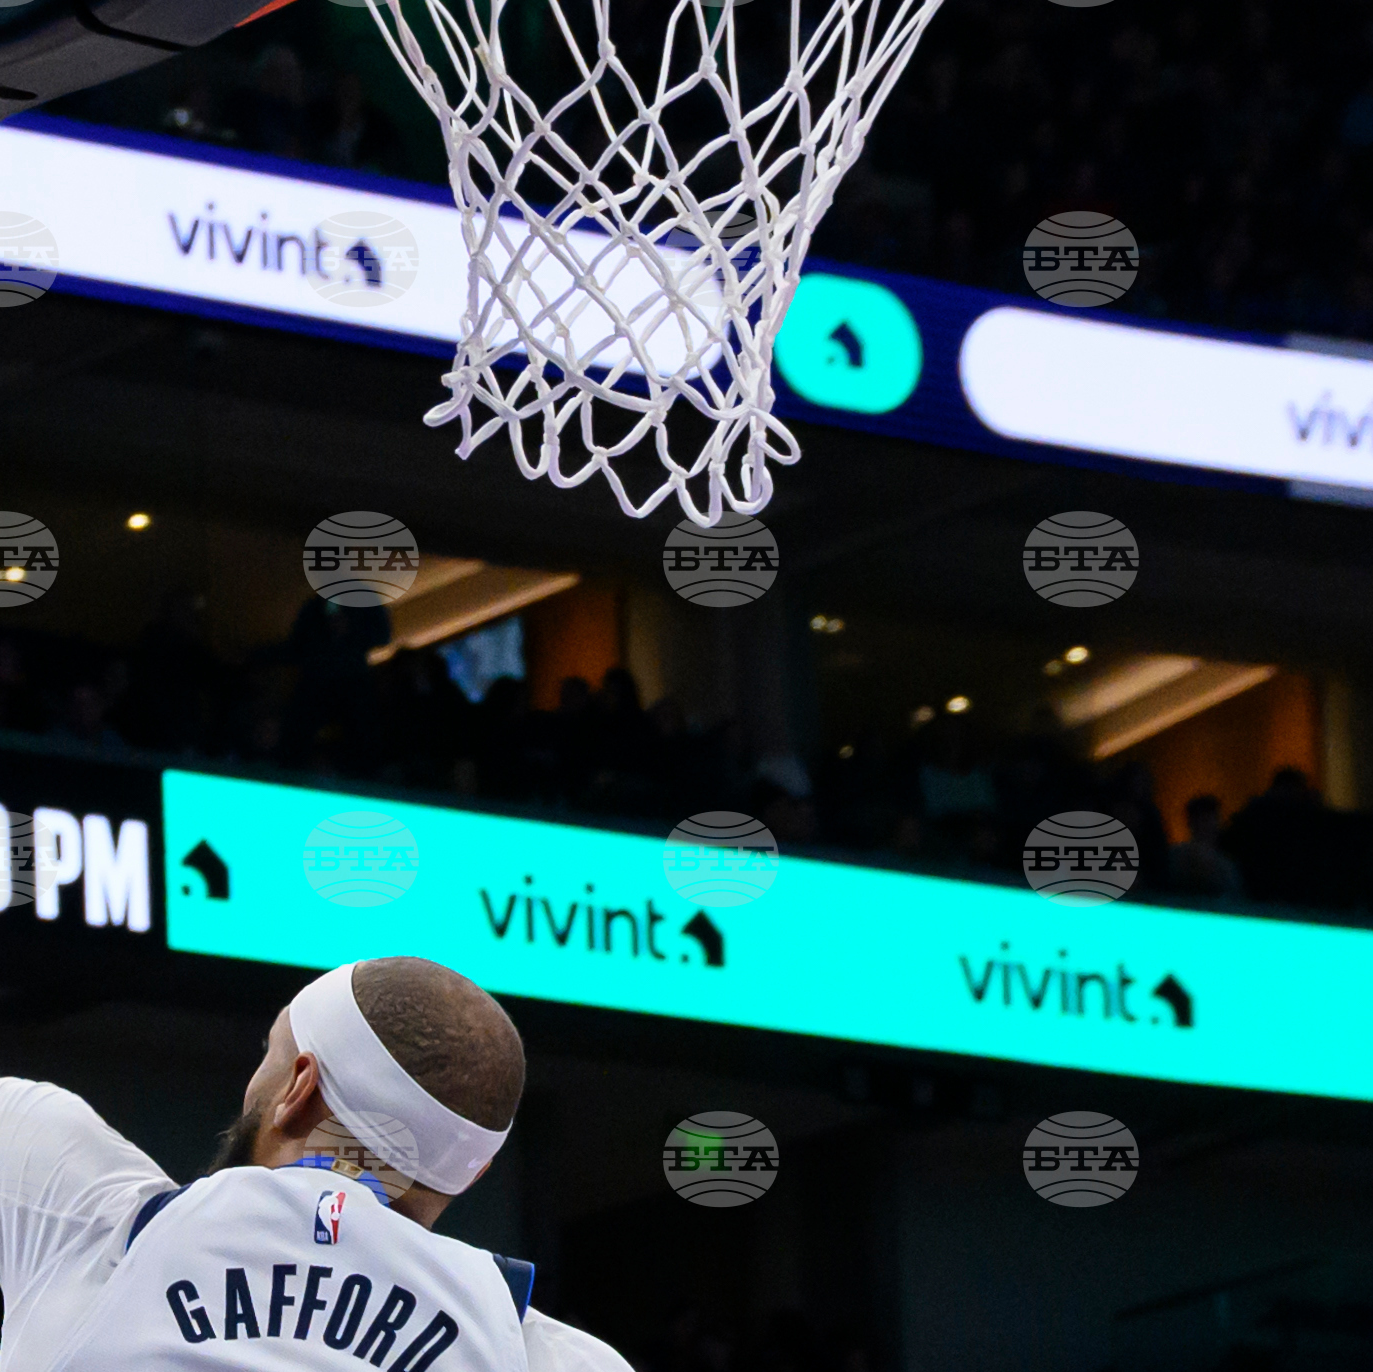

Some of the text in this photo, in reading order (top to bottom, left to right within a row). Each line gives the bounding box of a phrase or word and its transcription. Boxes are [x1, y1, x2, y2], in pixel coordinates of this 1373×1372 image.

[169, 203, 329, 280] vivint
[33, 806, 151, 932] PM
[481, 876, 666, 961] vivint
[959, 942, 1139, 1023] vivint
